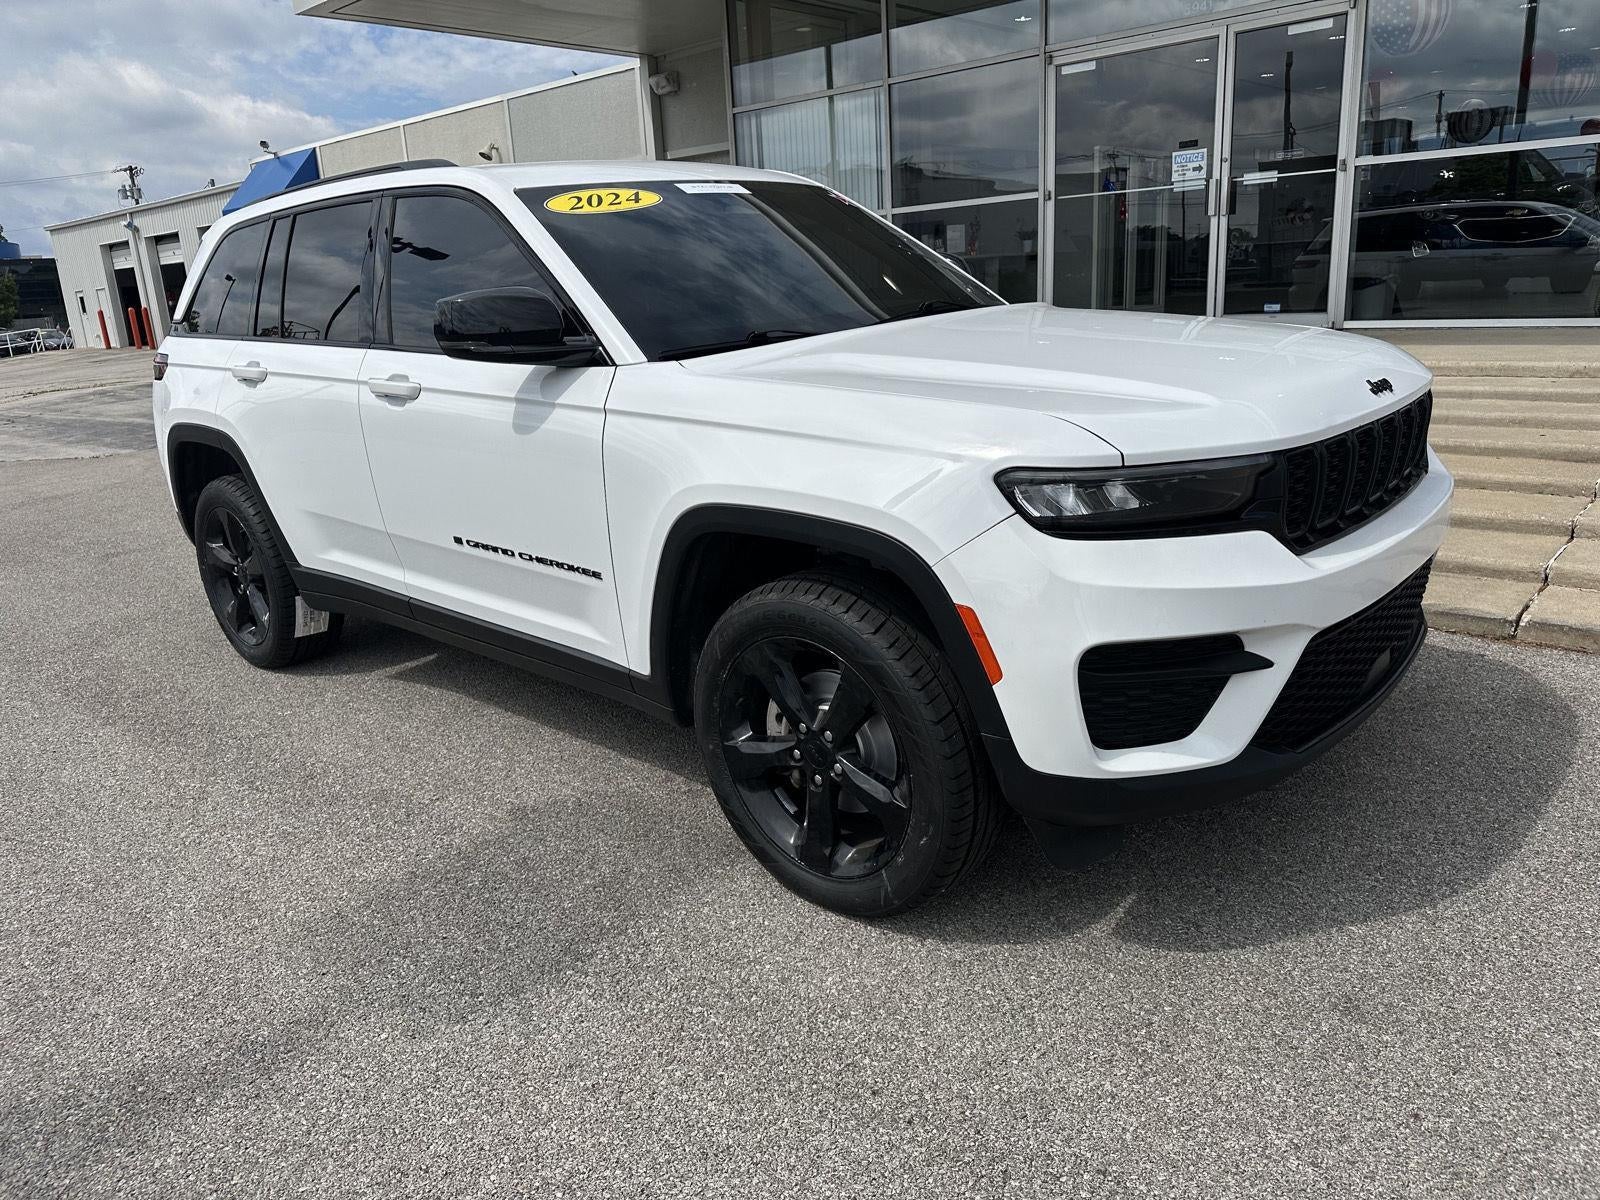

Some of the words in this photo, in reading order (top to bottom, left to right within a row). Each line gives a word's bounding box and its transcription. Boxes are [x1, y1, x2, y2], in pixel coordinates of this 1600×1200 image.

[1175, 153, 1203, 164] NOTICE
[568, 191, 641, 210] 2024
[466, 539, 515, 557] GRAND
[518, 552, 603, 580] CHEROKEE
